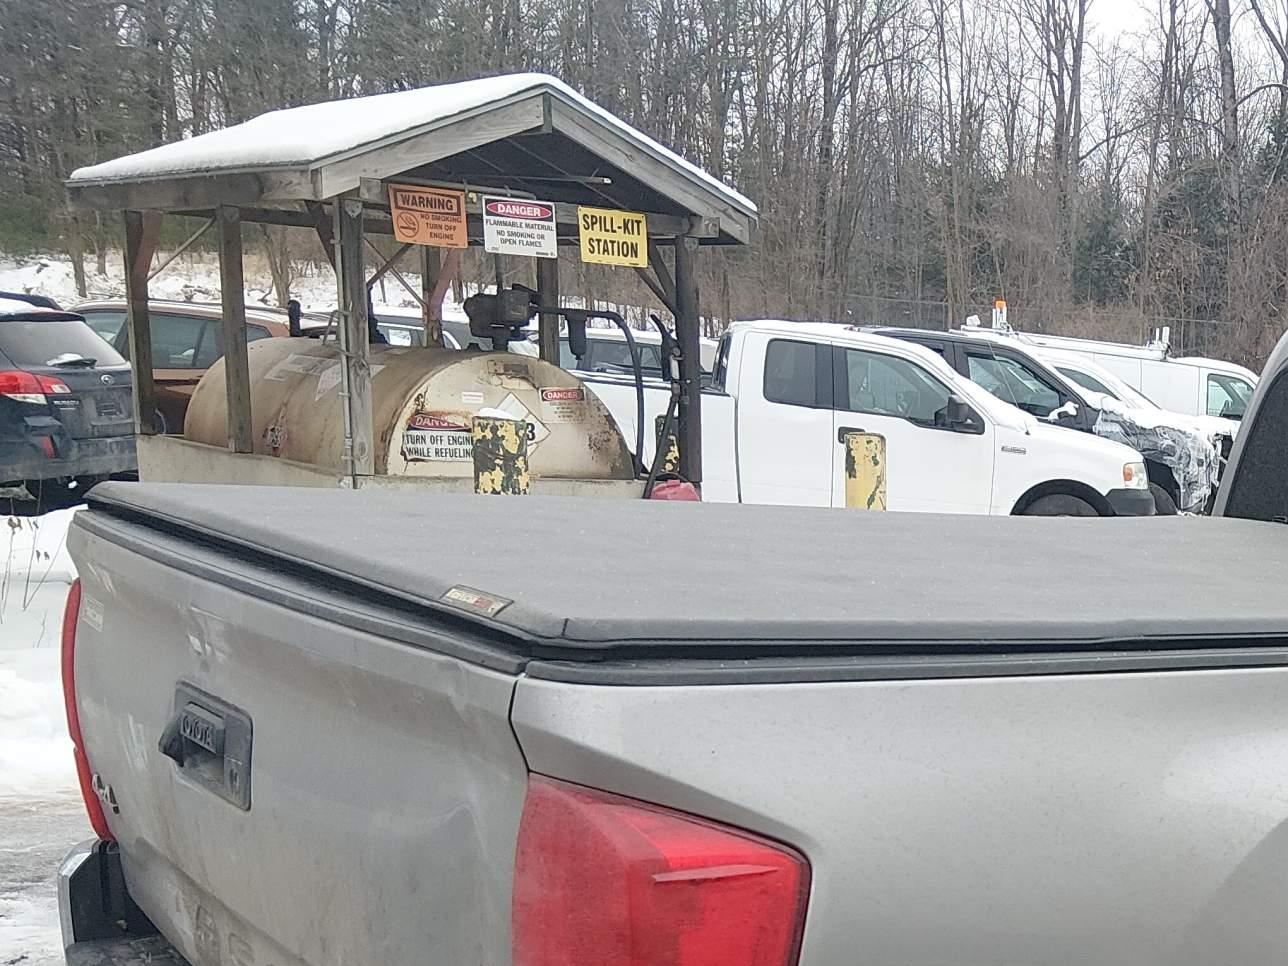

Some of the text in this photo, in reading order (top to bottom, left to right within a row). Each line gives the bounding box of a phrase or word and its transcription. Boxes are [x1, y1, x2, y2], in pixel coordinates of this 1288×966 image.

[400, 193, 454, 211] WARNING
[497, 203, 541, 217] DANGER
[420, 213, 462, 223] NO SMOKING
[425, 222, 457, 232] TURN OFF
[485, 218, 554, 232] FLAMMABLE MATERIAL
[582, 213, 642, 236] SPILL-KIT
[429, 231, 454, 240] ENGINE
[506, 230, 536, 240] SMOKING
[499, 237, 542, 248] OPEN FLAMES
[588, 237, 639, 259] STATION
[547, 391, 578, 399] DANGER
[526, 423, 536, 441] 3
[406, 434, 427, 445] TURN
[429, 434, 445, 446] OFF
[406, 446, 474, 459] WHILE REFUELIN
